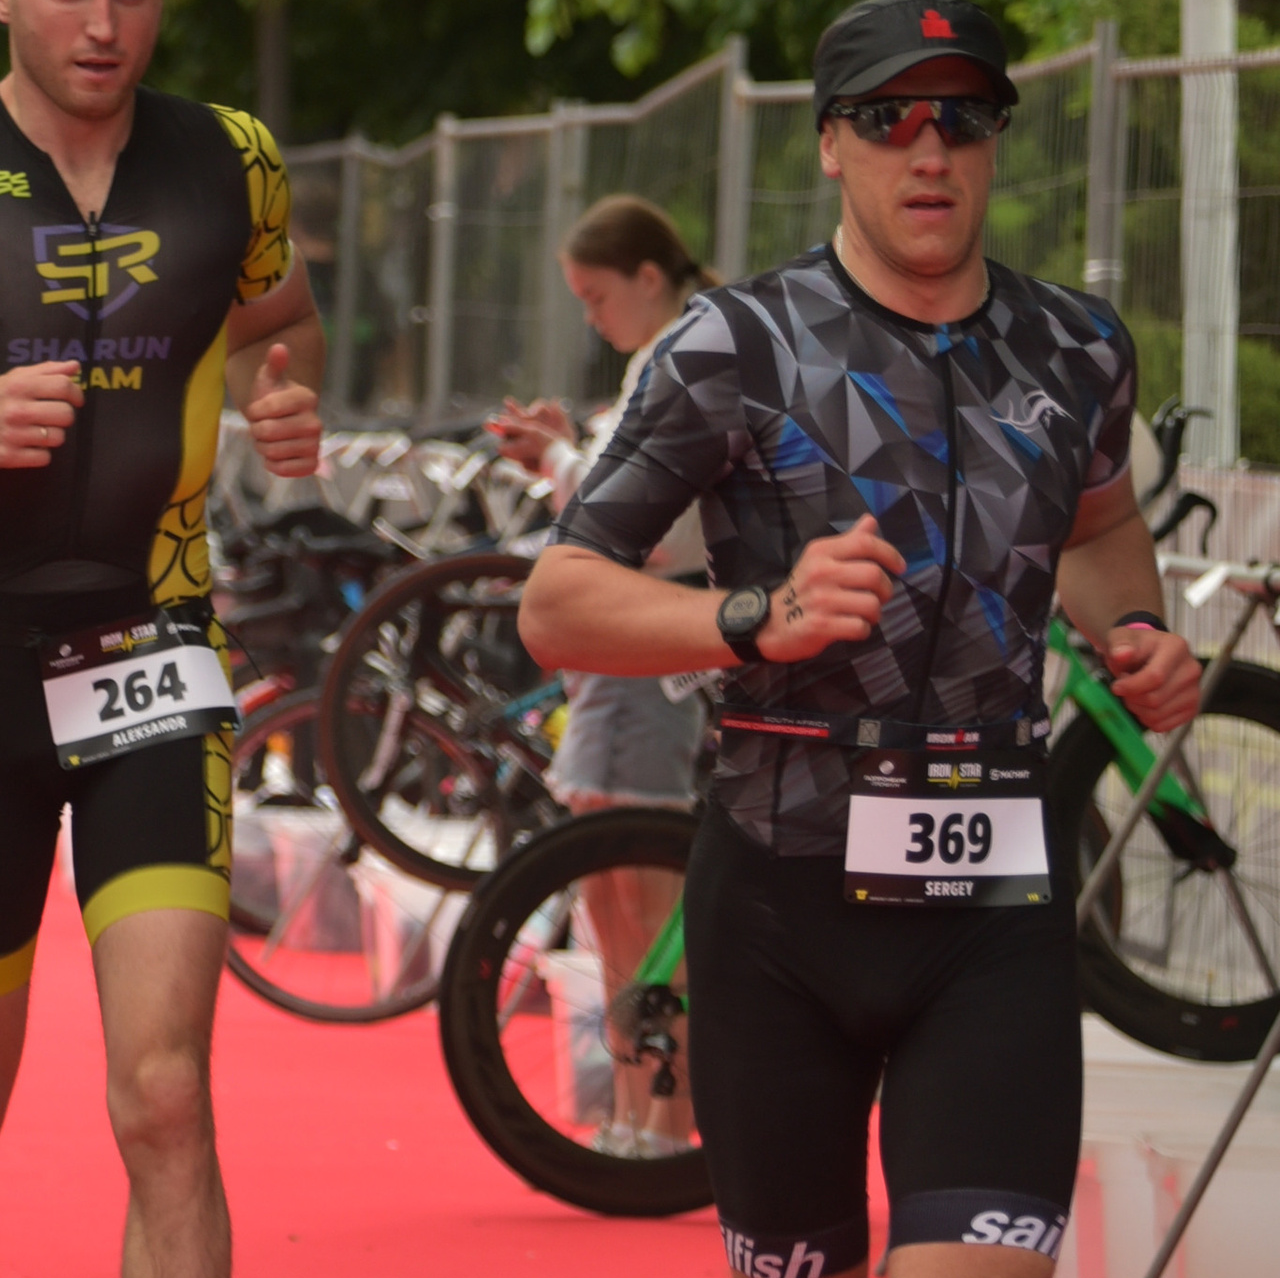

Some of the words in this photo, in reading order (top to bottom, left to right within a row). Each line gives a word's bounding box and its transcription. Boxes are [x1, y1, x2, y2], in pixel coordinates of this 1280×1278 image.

[6, 336, 172, 363] SHARUN
[130, 622, 159, 640] STAR
[92, 661, 188, 723] 264
[112, 715, 187, 748] ALEKSANDR
[796, 719, 830, 728] AFRICA
[927, 763, 953, 778] IRON
[959, 763, 982, 778] STAR
[905, 812, 992, 864] 369
[925, 881, 974, 897] SERGEY
[961, 1210, 1066, 1262] sai
